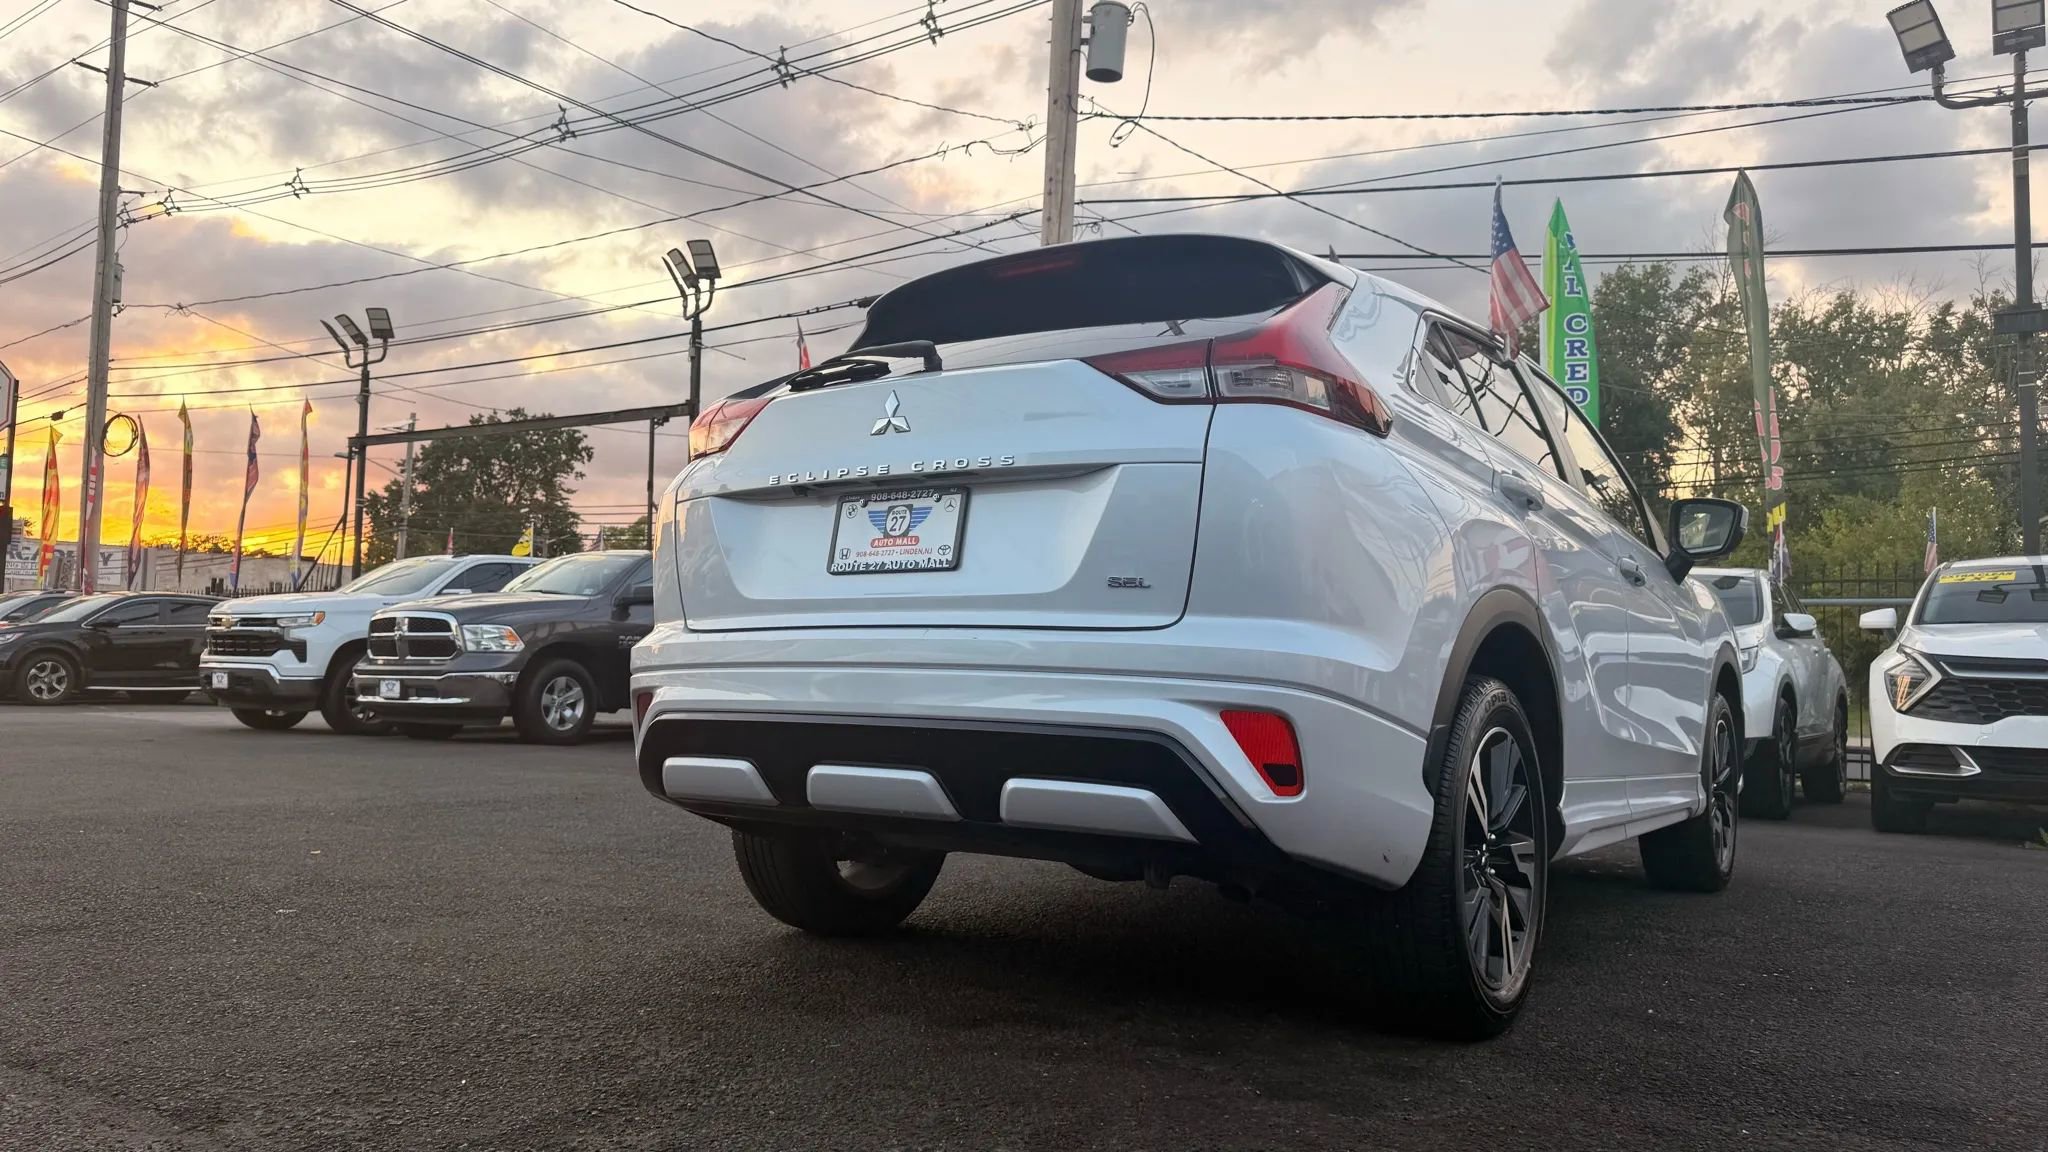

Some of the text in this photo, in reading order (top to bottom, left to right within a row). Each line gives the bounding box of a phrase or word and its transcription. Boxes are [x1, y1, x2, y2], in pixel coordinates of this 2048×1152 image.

[769, 455, 1015, 485] ECLIPSE CROSS
[871, 489, 934, 501] 908-648-2727
[889, 515, 906, 532] 27
[873, 537, 917, 547] AUTO MALL
[830, 558, 950, 572] ROUTE 27 AUTO MALL
[1107, 576, 1152, 588] SEL
